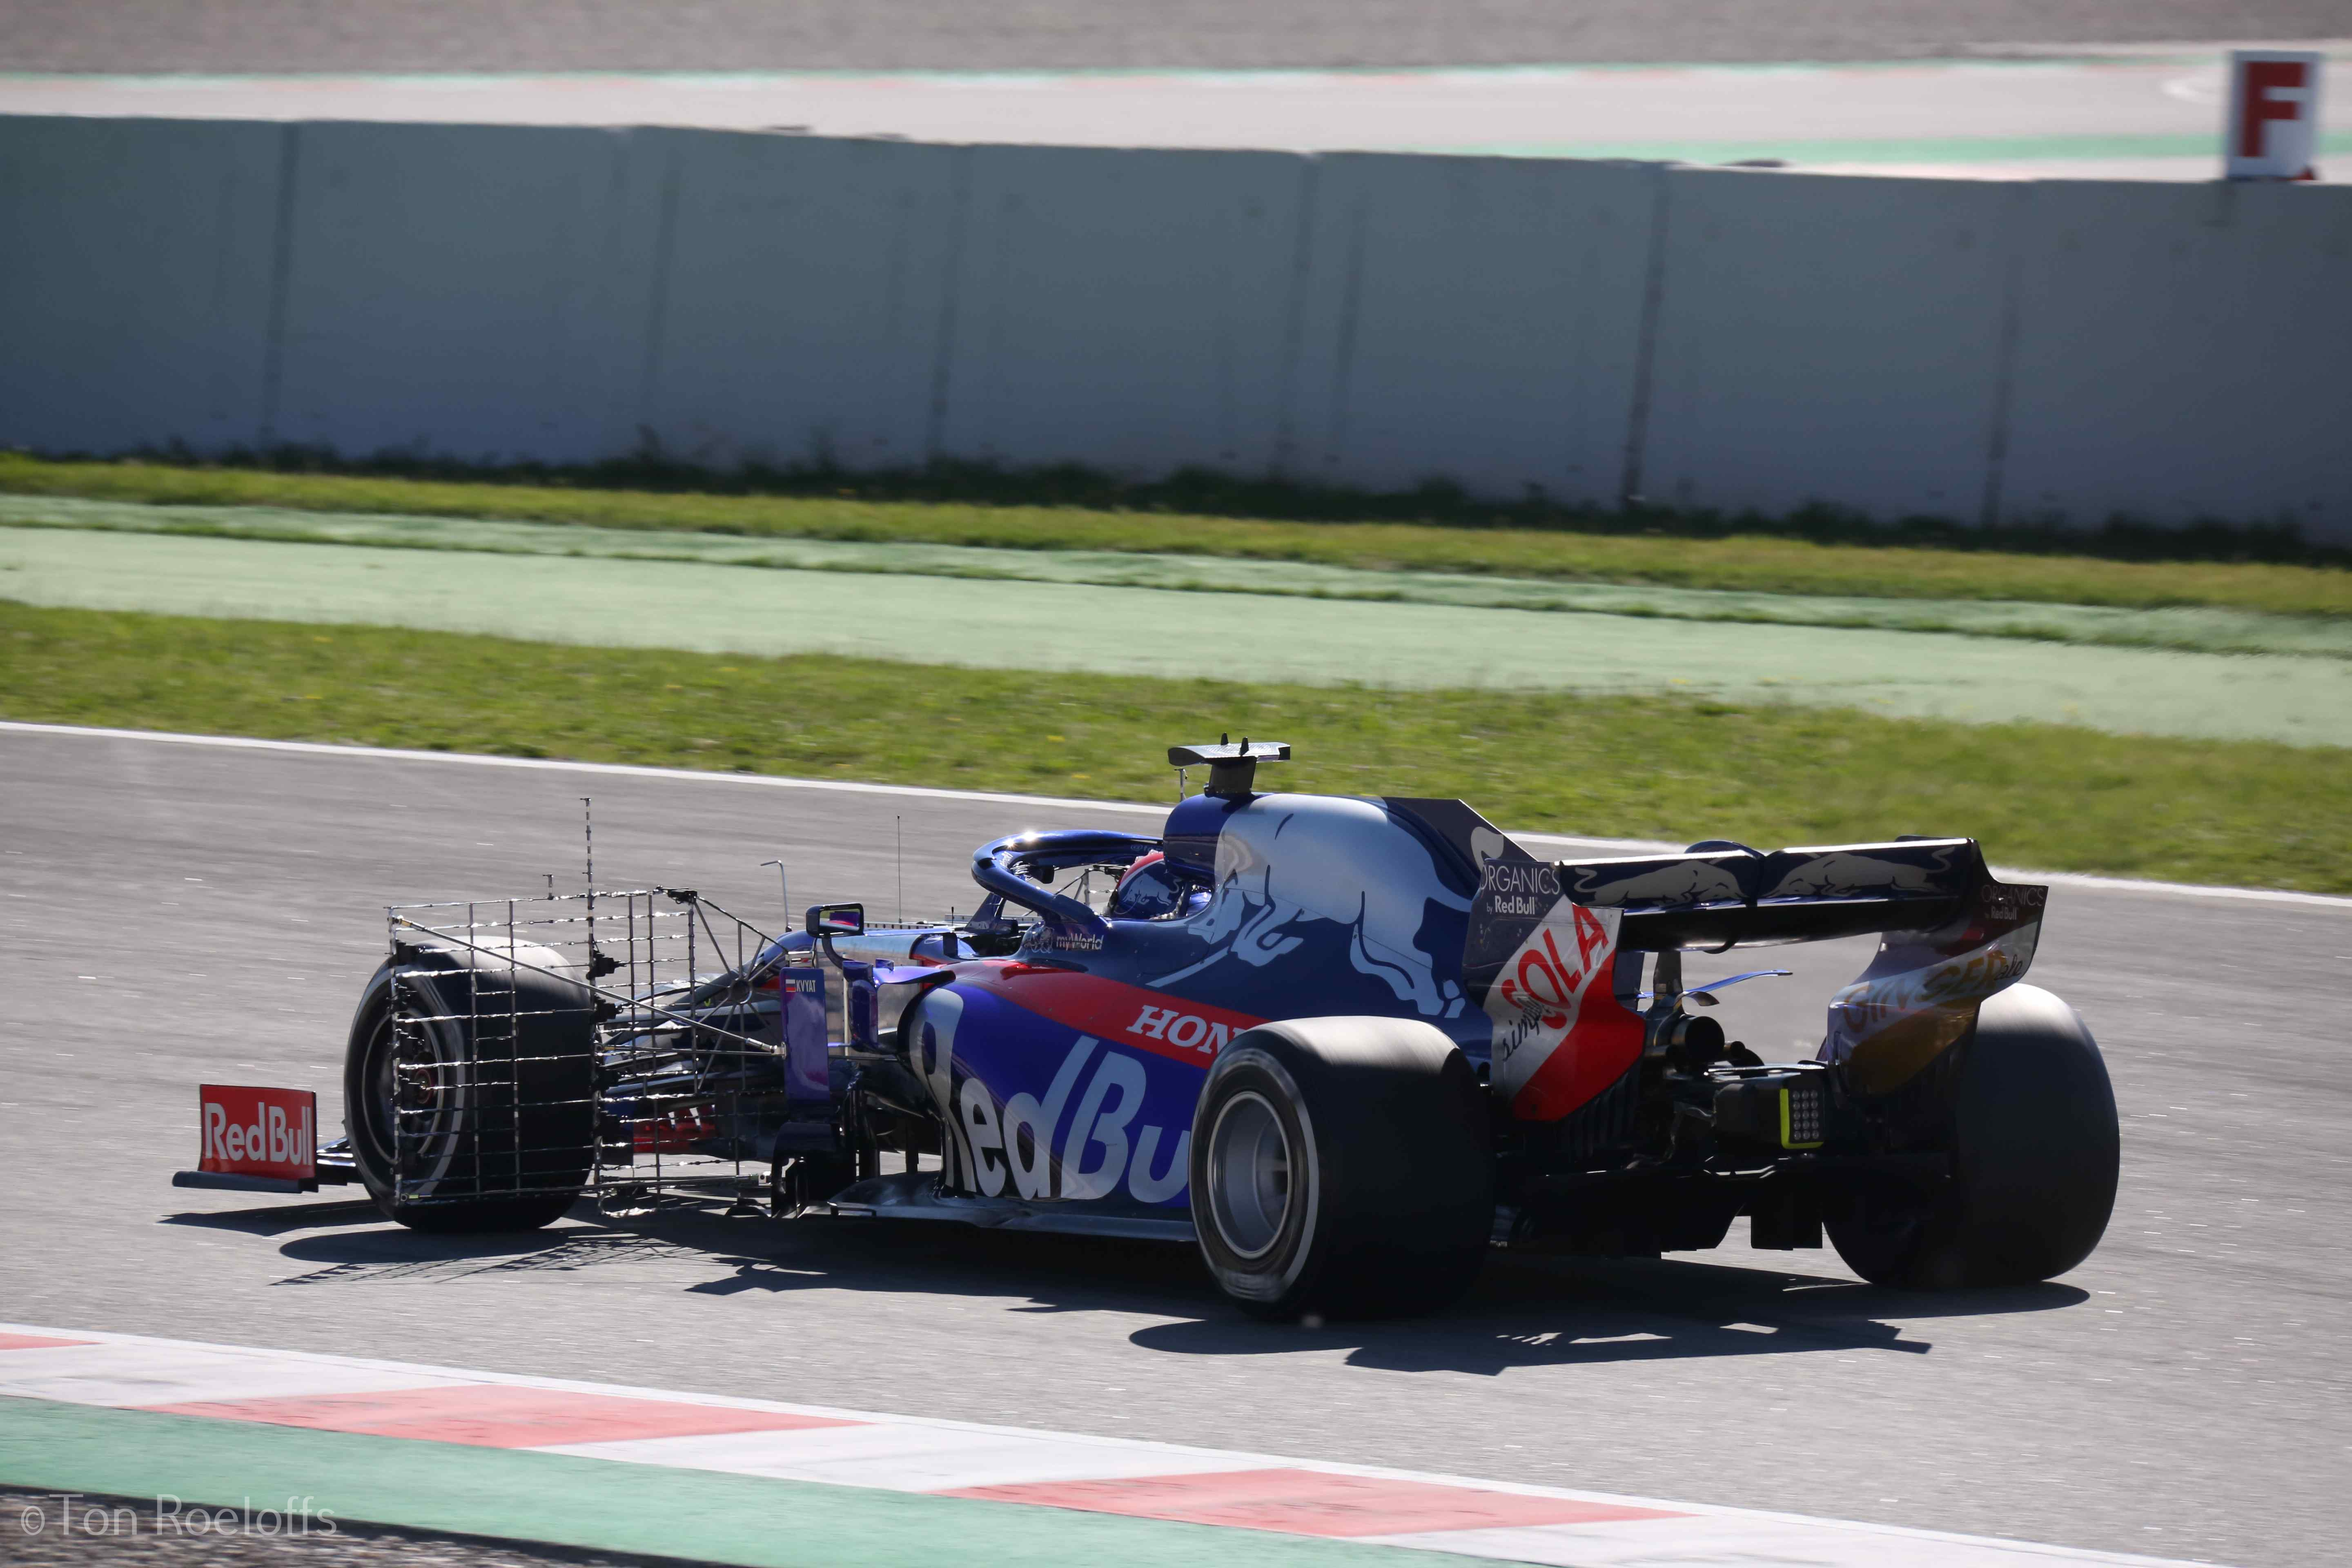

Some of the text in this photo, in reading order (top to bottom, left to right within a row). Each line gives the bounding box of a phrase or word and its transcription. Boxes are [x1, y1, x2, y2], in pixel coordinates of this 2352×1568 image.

[2240, 62, 2307, 157] F
[1486, 895, 1535, 915] by Red Bull
[1981, 884, 2044, 907] ORGANICS
[1991, 905, 2004, 920] Red
[2004, 906, 2017, 920] Bull
[1056, 933, 1104, 951] myWorld
[1993, 954, 2023, 980] ale
[796, 980, 816, 992] KVYAT
[1125, 1004, 1246, 1054] HON
[205, 1102, 313, 1166] Red Bull
[1060, 1051, 1189, 1203] Bu
